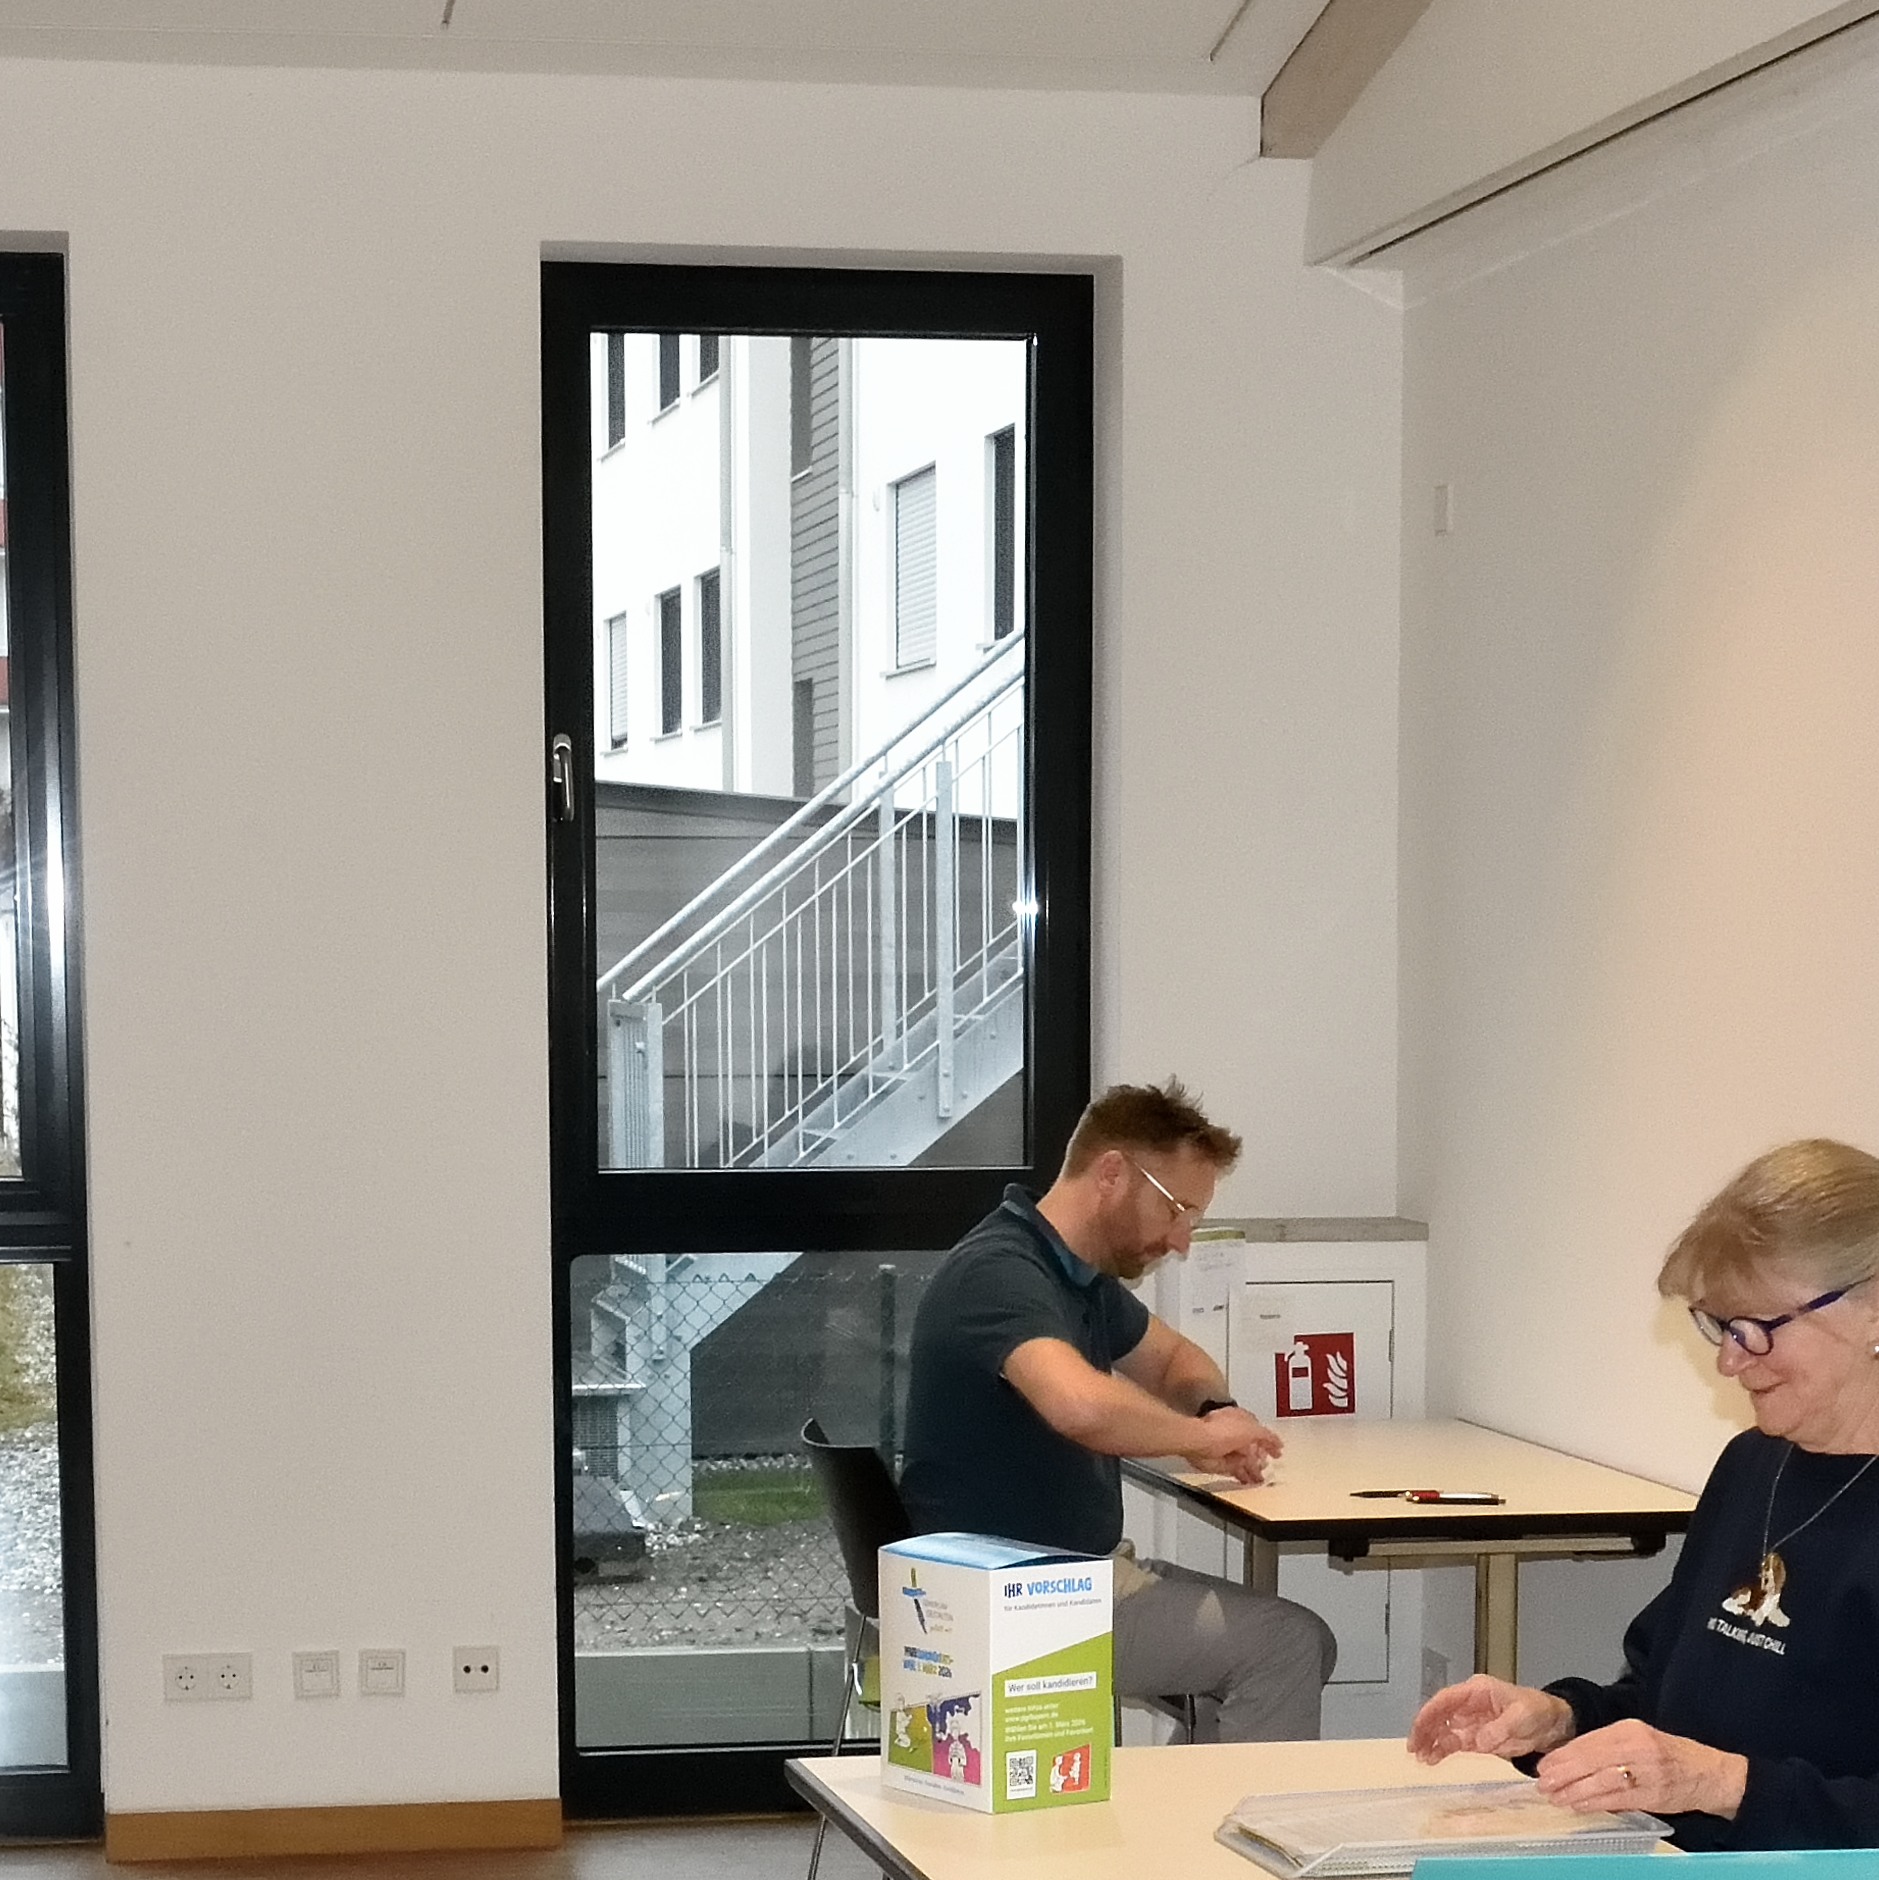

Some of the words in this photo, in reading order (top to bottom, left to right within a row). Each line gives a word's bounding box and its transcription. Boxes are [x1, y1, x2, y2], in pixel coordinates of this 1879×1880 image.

[1004, 1583, 1023, 1598] IHR
[1026, 1577, 1092, 1596] VORSCHLAG
[1008, 1684, 1024, 1692] Wer
[1027, 1682, 1040, 1691] soll
